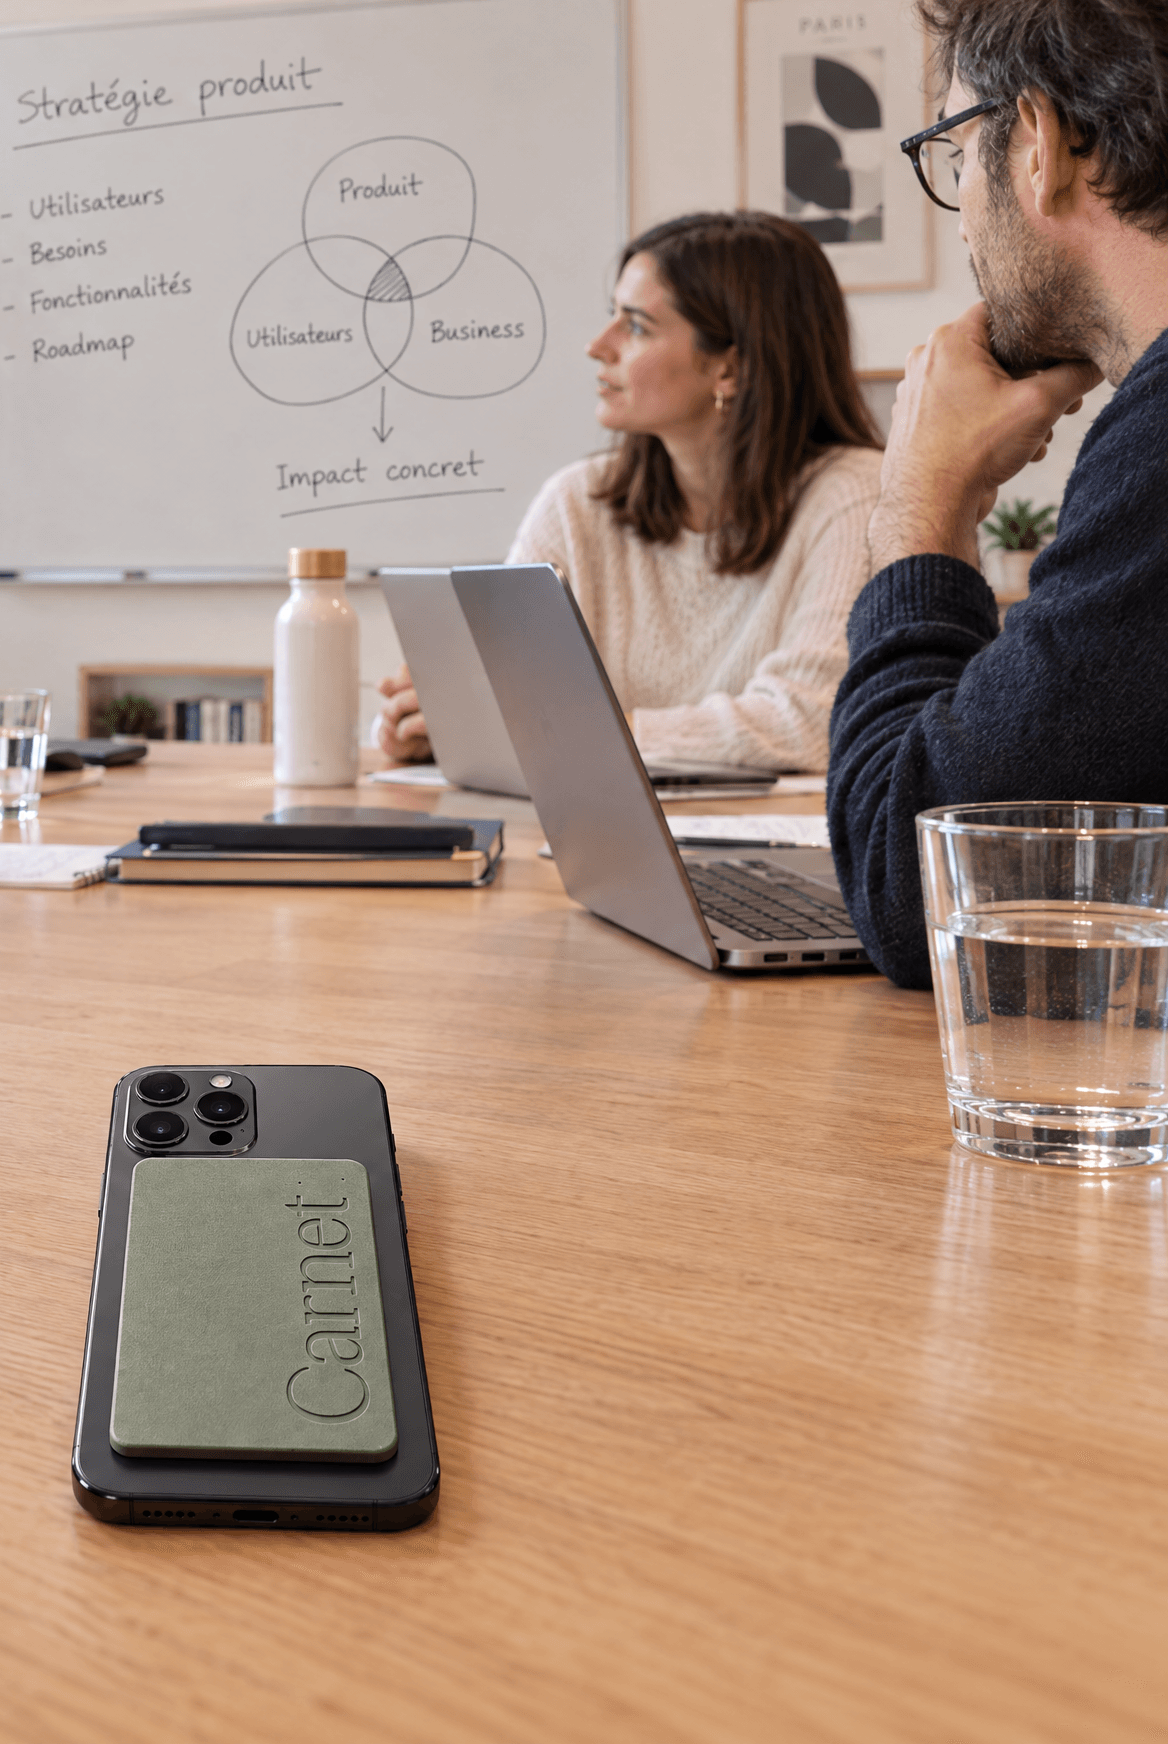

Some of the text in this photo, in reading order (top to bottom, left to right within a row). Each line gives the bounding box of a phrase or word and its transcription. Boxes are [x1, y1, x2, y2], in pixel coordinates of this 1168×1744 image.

[18, 57, 322, 126] Stratégie produit
[30, 186, 165, 220] Utilisateurs
[339, 172, 424, 203] Produit
[29, 238, 108, 265] Besoins
[30, 271, 192, 314] Fonctionnalités
[32, 331, 135, 363] Roadmap
[247, 323, 353, 348] Utilisateurs
[430, 320, 525, 343] Business
[276, 449, 485, 498] Impact concret
[285, 1194, 371, 1425] Carnet
